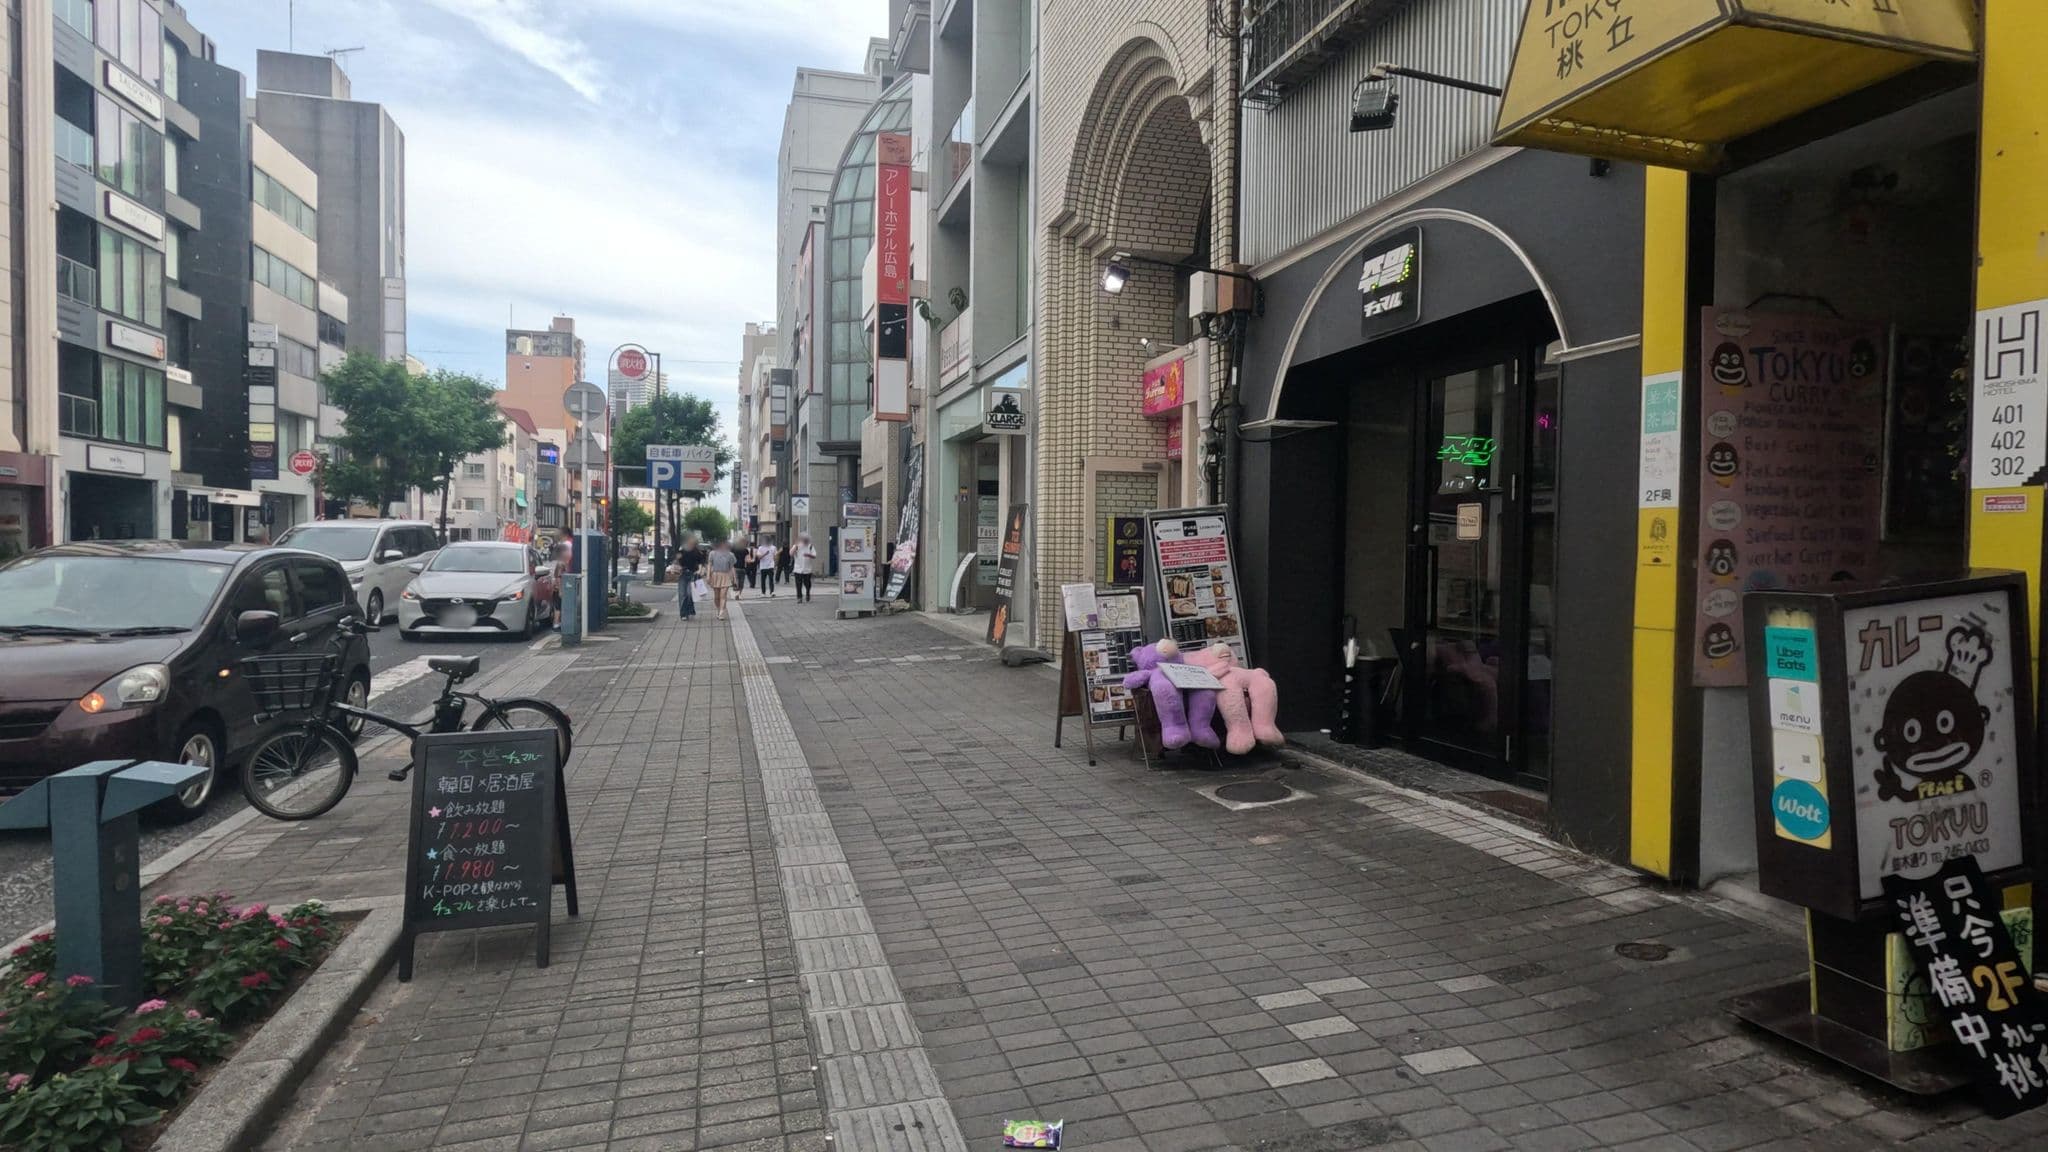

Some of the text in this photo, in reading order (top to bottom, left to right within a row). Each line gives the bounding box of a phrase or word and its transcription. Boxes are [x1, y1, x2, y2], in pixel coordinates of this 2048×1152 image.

[883, 168, 899, 279] アレーホテル広島
[1363, 290, 1404, 318] チュマル
[1749, 346, 1846, 386] TOKYU
[1983, 387, 2018, 398] HOTEL
[988, 413, 1024, 425] XLARGE
[1991, 403, 2024, 425] 401
[1991, 430, 2026, 451] 402
[650, 447, 713, 459] 自転車 バイク
[652, 461, 675, 490] P
[1991, 456, 2026, 477] 302
[1645, 488, 1672, 502] 2F奥
[1776, 645, 1805, 660] Uber
[1858, 613, 1943, 671] カレー
[1776, 657, 1806, 672] Eats
[1779, 712, 1811, 726] menu
[1917, 776, 1965, 801] PEACE
[443, 799, 506, 819] 飲み放題
[1778, 795, 1823, 825] Wolt
[1889, 801, 1990, 852] TOKYU
[1891, 849, 1928, 871] 並木通り
[1942, 874, 1997, 959] 只今
[1896, 890, 1992, 1060] 準備中
[1971, 960, 2026, 1013] 2F
[2000, 1022, 2047, 1049] カレー
